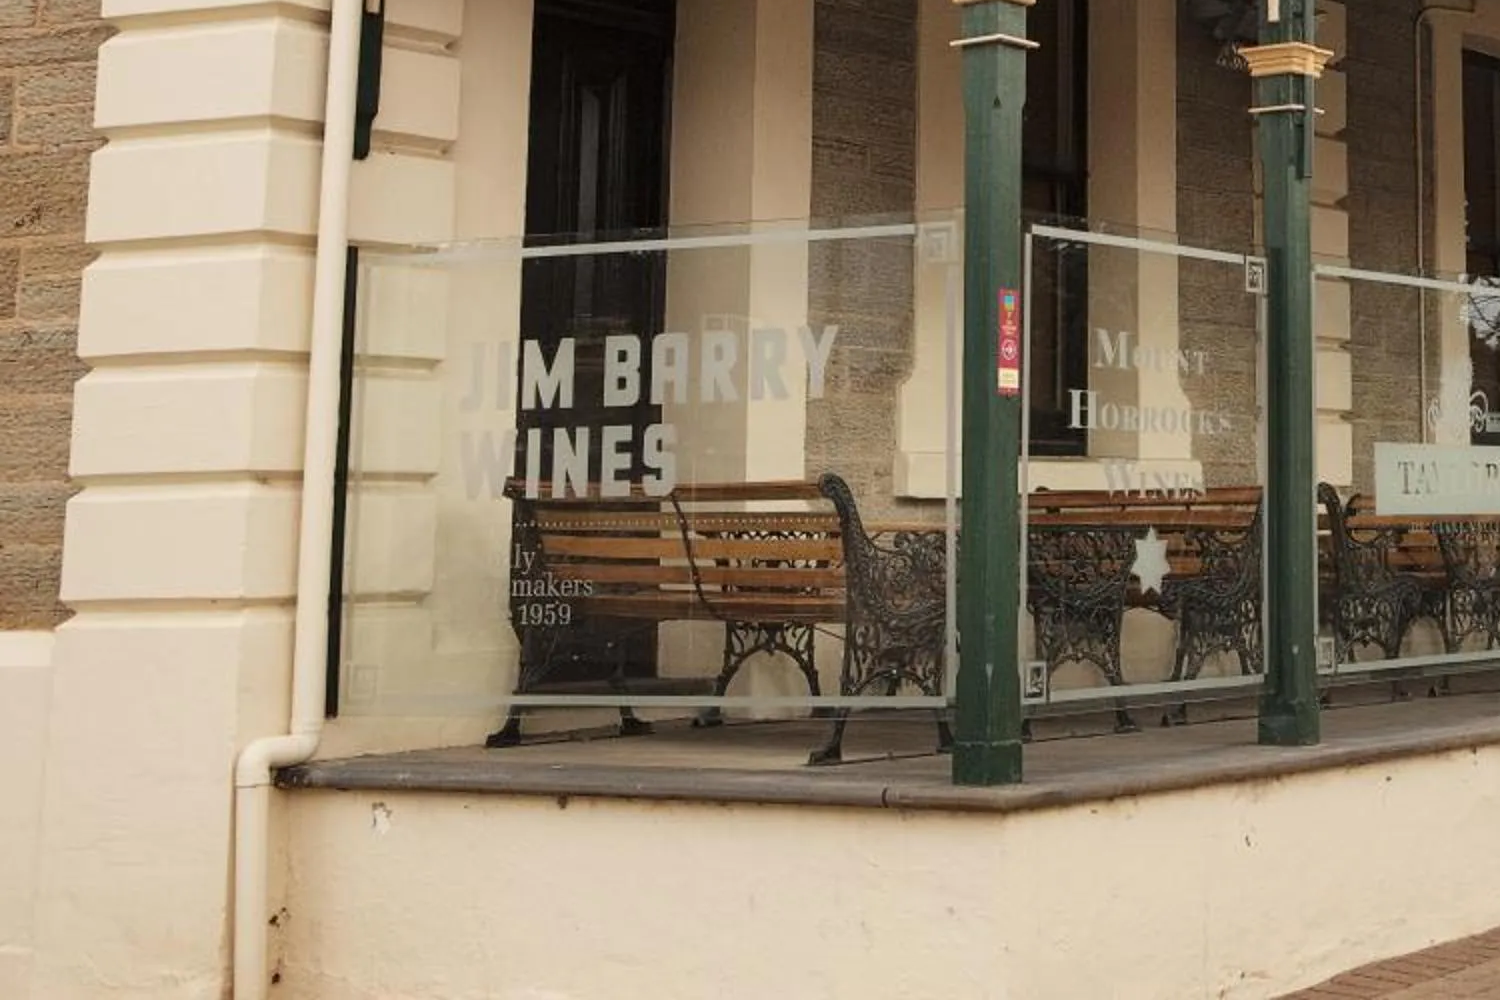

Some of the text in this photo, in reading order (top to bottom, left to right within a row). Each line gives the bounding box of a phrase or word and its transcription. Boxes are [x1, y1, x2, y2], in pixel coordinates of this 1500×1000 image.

[460, 325, 839, 412] JIM BARRY
[459, 423, 679, 502] WINES
[517, 603, 571, 627] 1959
